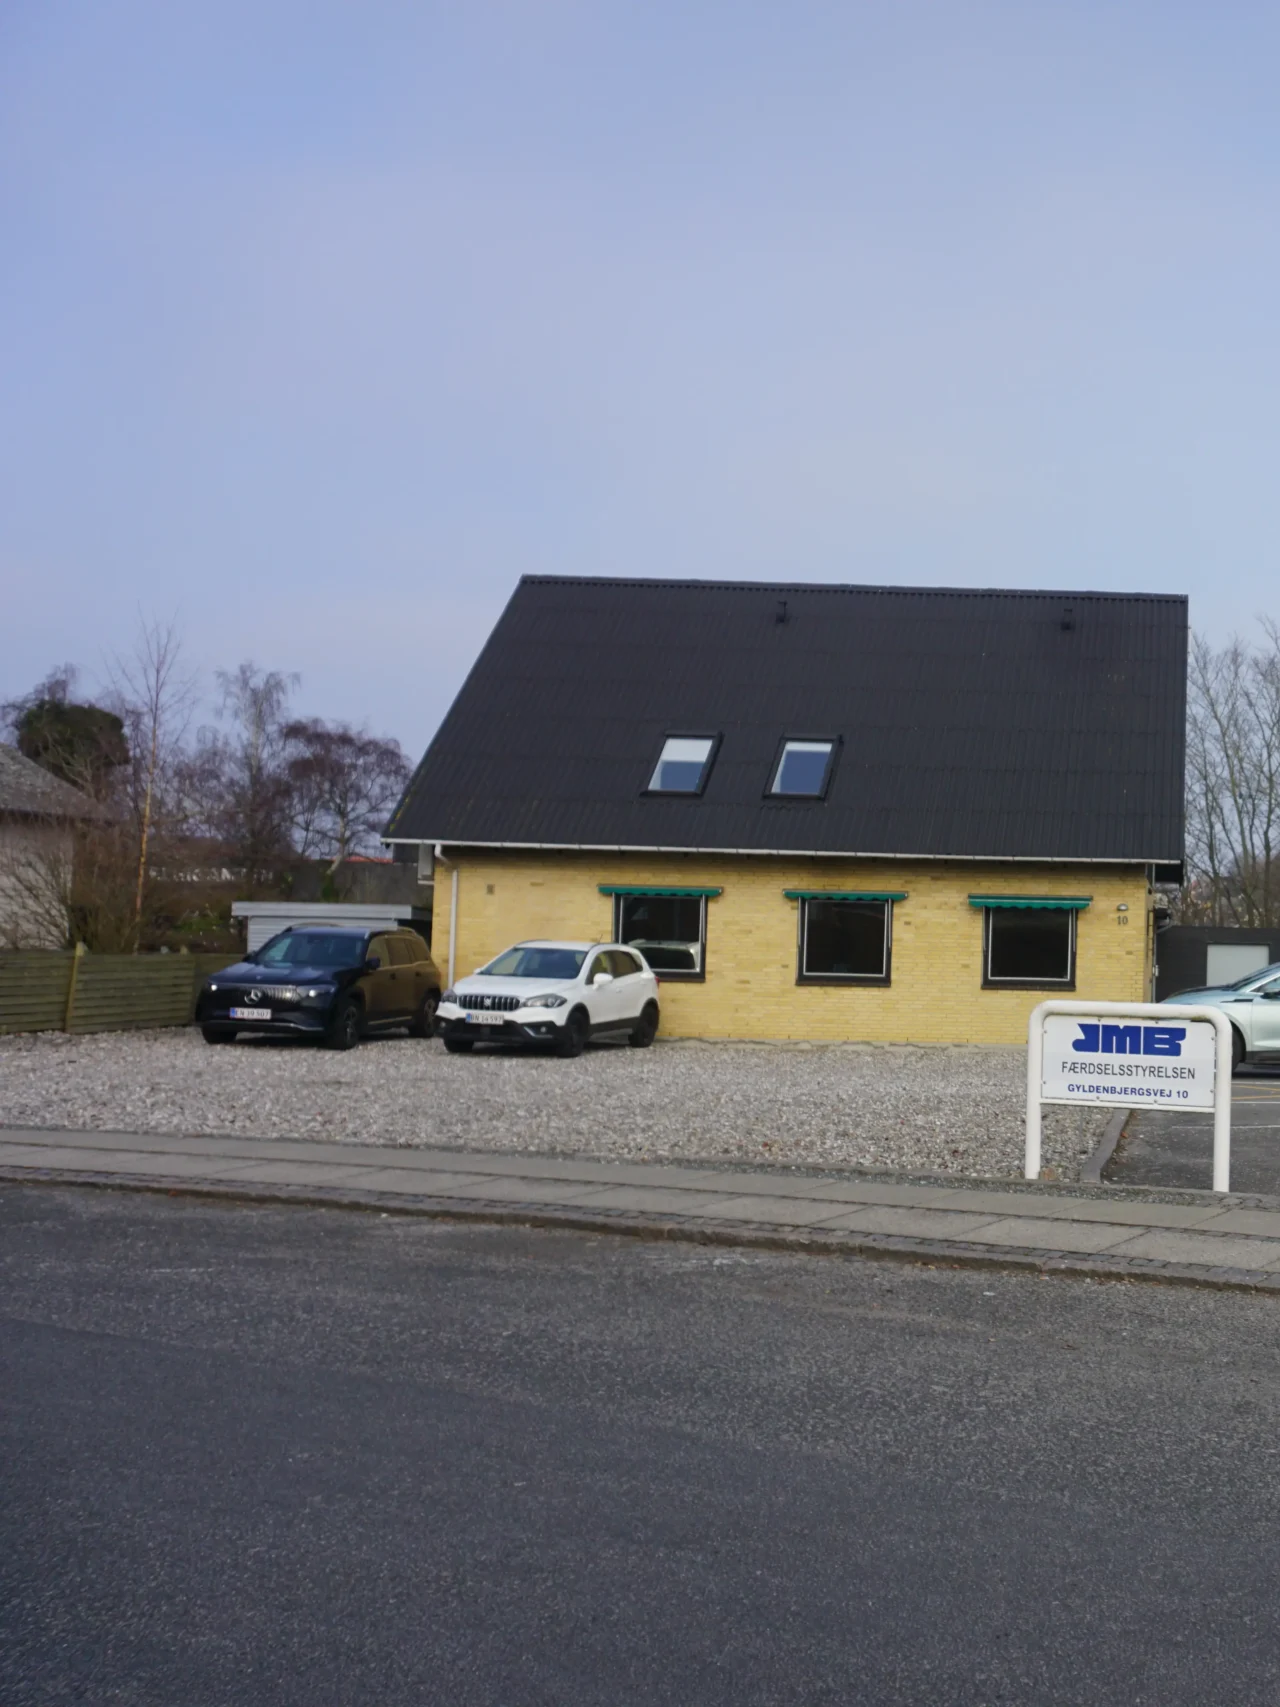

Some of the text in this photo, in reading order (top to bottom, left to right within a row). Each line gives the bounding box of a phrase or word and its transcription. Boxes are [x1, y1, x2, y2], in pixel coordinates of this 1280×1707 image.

[1117, 915, 1129, 925] 10
[1071, 1023, 1187, 1057] JMB
[1061, 1061, 1196, 1080] FÆRDSELSSTYRELSEN
[1067, 1083, 1189, 1099] GYLDENBJERGSVEJ 10
